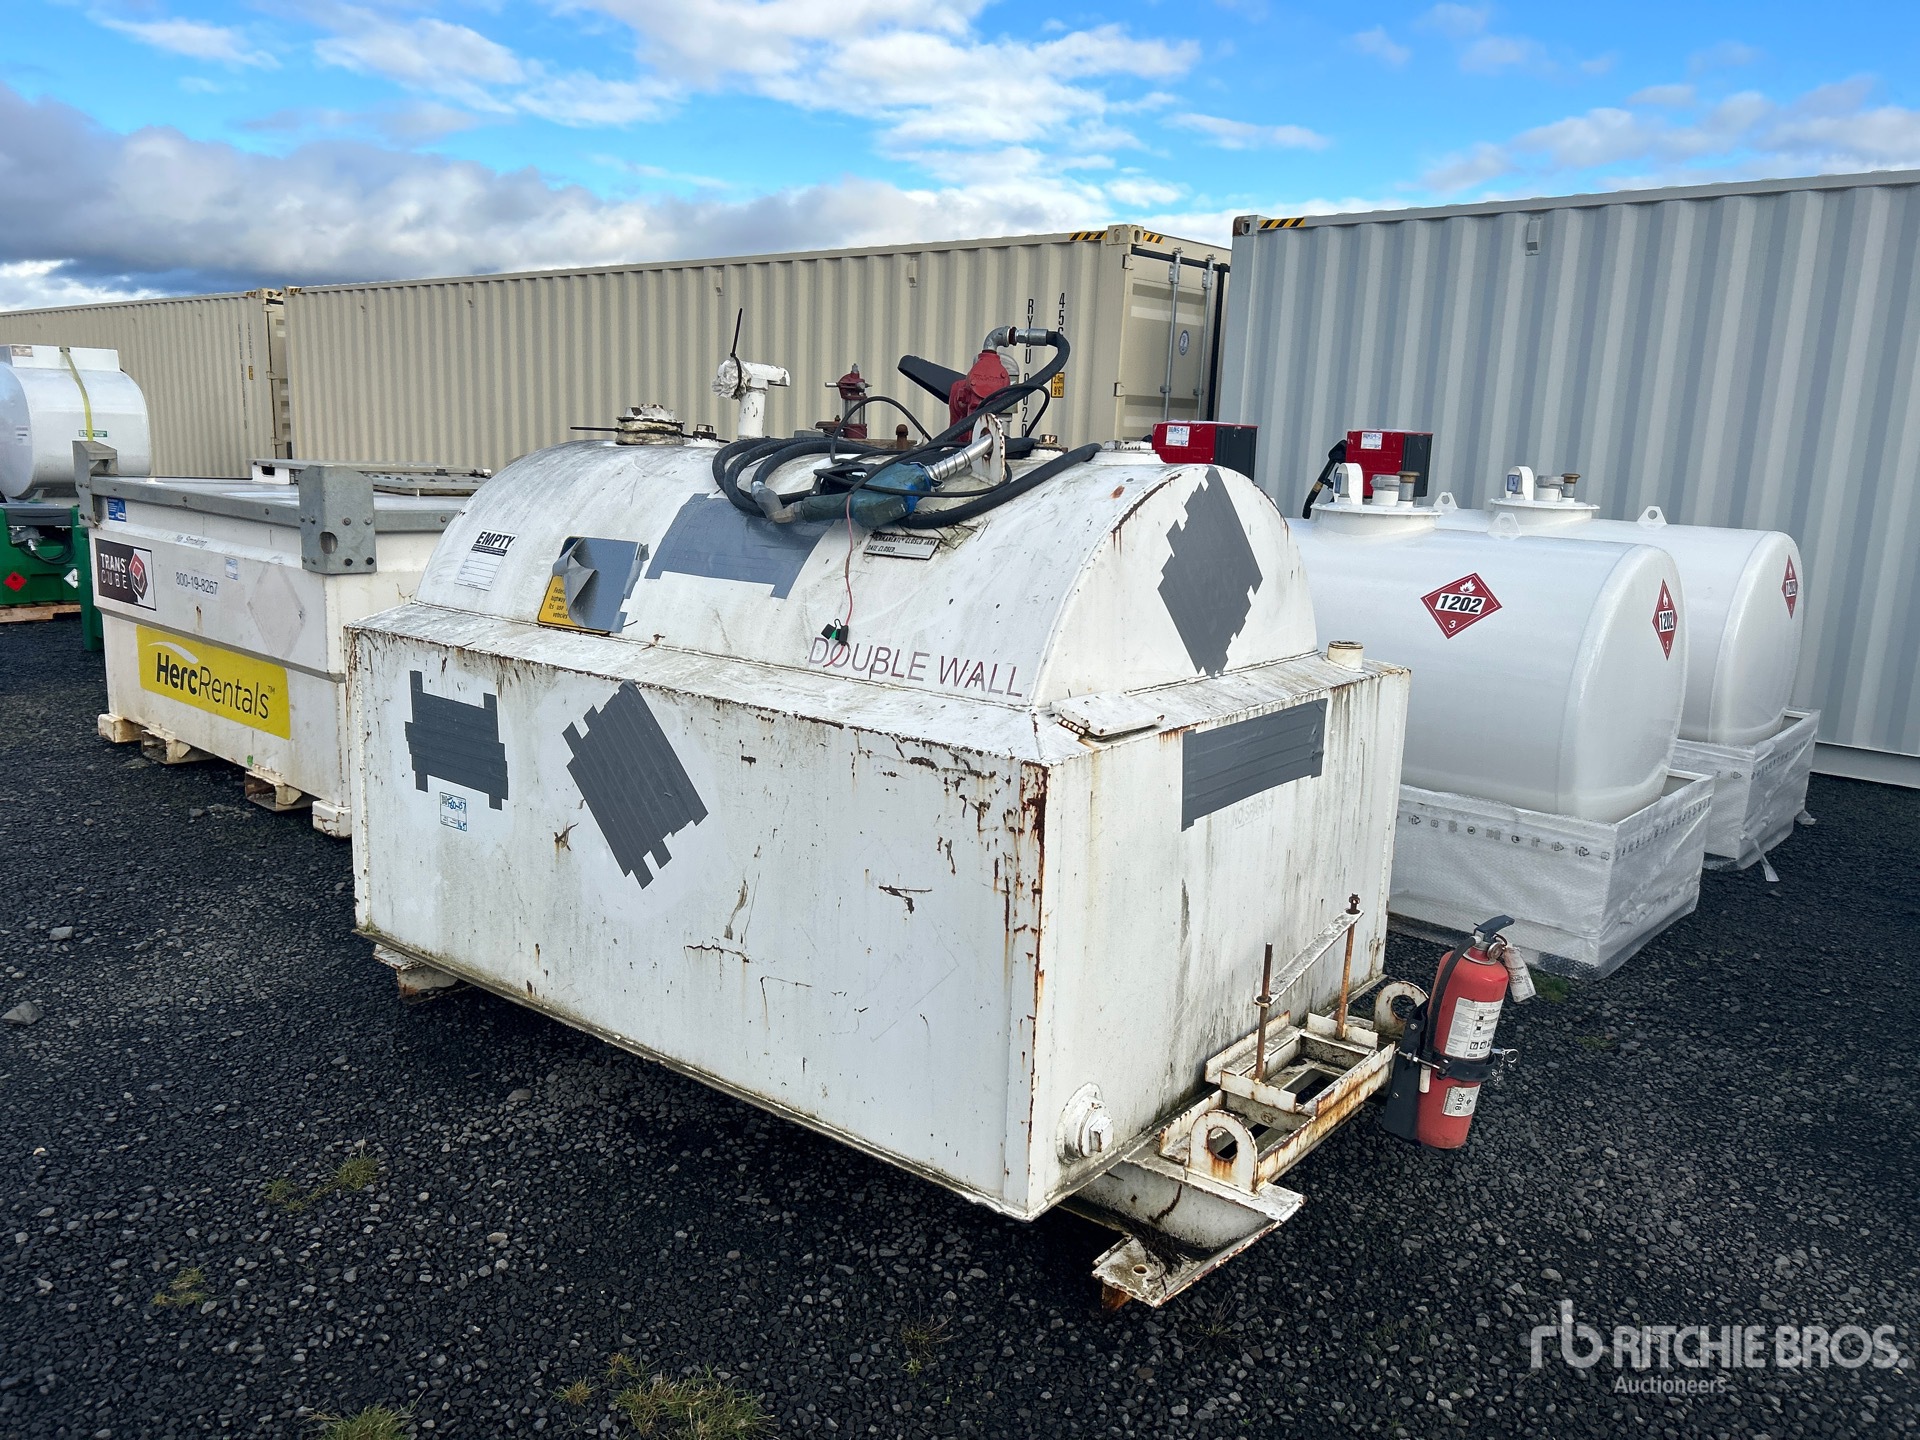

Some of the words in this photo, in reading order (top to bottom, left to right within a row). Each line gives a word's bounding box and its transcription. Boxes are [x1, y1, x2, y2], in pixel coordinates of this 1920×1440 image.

[475, 531, 516, 549] EMPTY
[100, 553, 127, 572] TRANS
[101, 569, 128, 590] CUBE
[175, 571, 219, 596] 800-19-8267
[1439, 594, 1483, 613] 1202
[1448, 619, 1457, 629] 3
[1659, 611, 1674, 631] 1202
[808, 637, 930, 681] DOUBLE
[939, 655, 1023, 698] WALL
[156, 652, 270, 720] HercRentals
[1454, 1093, 1466, 1111] 2018
